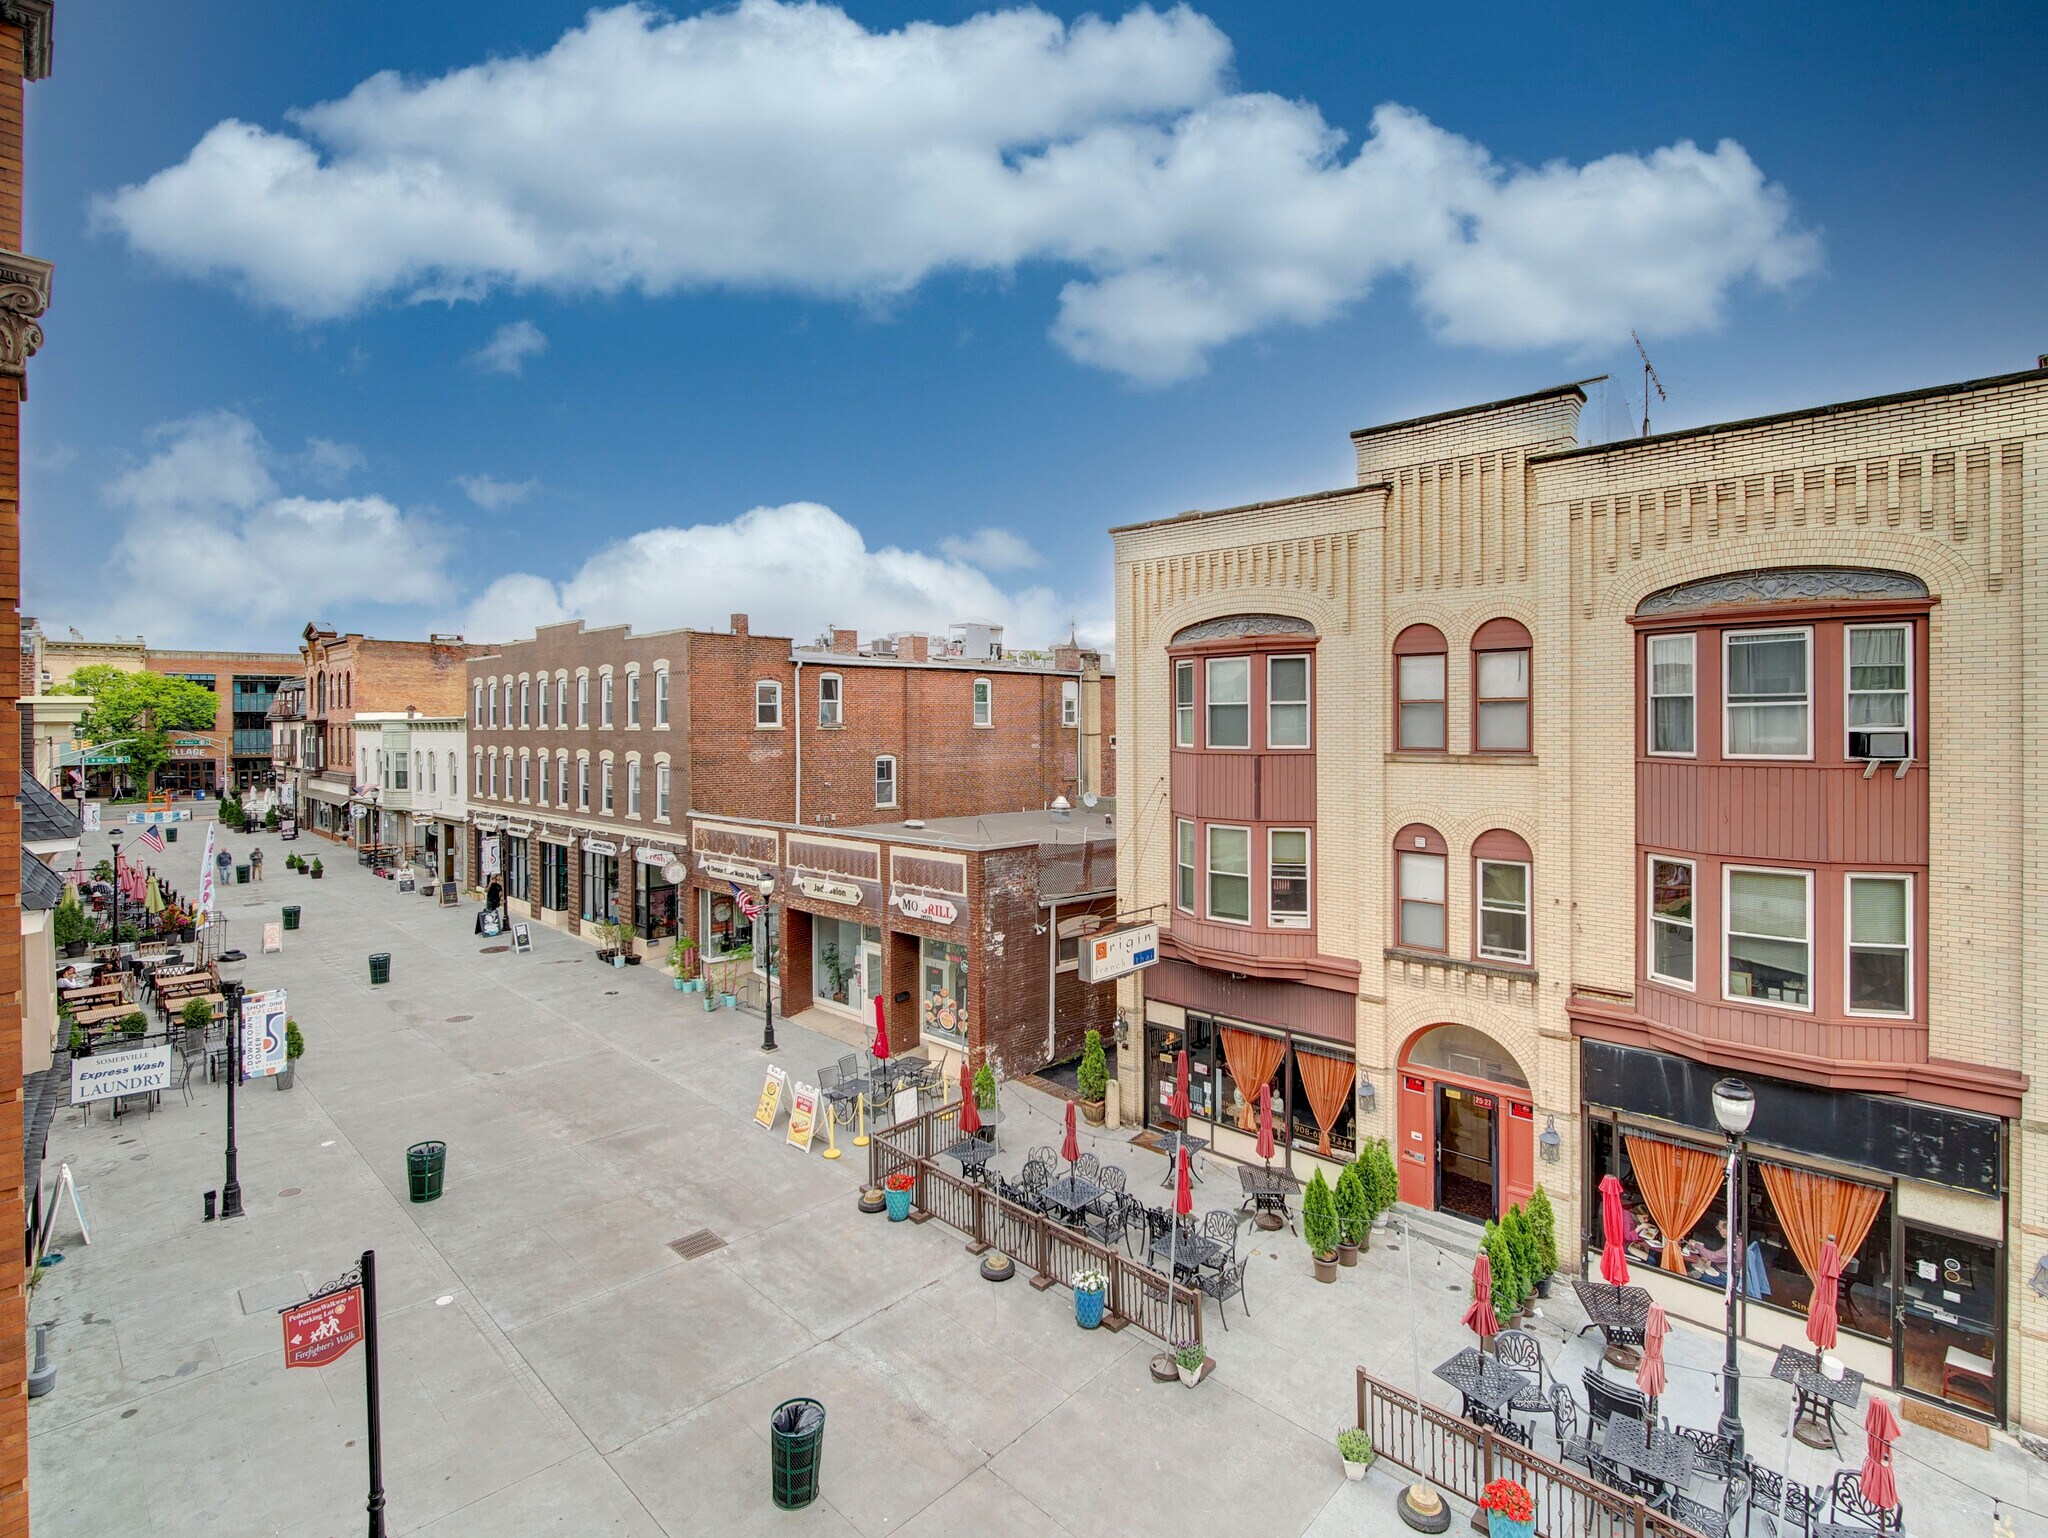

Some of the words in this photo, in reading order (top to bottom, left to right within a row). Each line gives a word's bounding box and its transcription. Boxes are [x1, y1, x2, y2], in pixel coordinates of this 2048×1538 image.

[646, 853, 666, 862] resh
[746, 871, 755, 881] Shop
[813, 883, 827, 893] Jad
[1095, 958, 1126, 975] french
[1135, 951, 1153, 964] thai
[246, 1003, 266, 1011] SHOP
[246, 1007, 283, 1016] EXPLORE
[96, 1052, 149, 1065] SOMERVILLE
[79, 1067, 129, 1081] Express
[133, 1060, 165, 1072] Wash
[80, 1072, 164, 1098] LAUNDRY
[288, 1306, 321, 1323] Pedestrian
[321, 1296, 347, 1310] Walkway
[298, 1314, 323, 1327] Parking
[323, 1309, 334, 1318] Lot
[295, 1339, 335, 1361] Firefighter's
[336, 1331, 355, 1344] Walk
